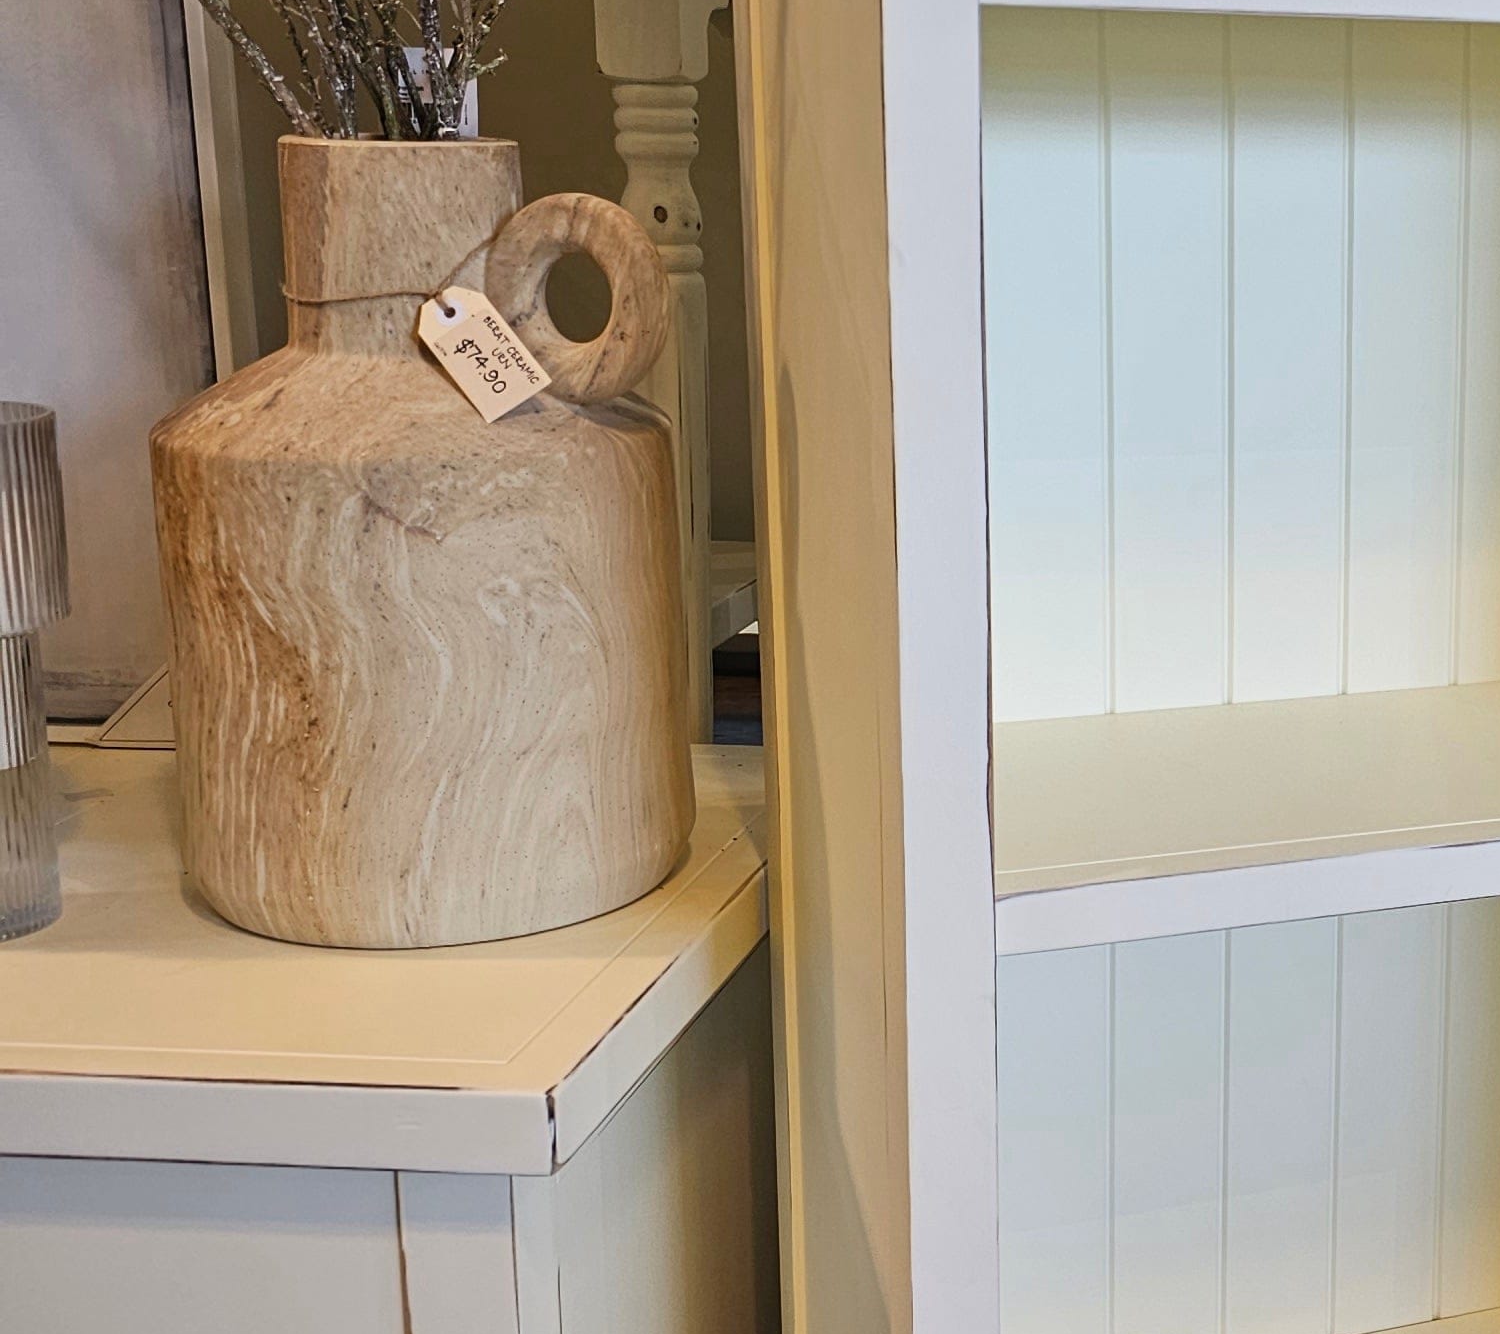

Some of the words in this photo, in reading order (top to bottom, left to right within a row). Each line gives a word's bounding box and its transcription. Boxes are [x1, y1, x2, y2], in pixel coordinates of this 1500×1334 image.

[453, 338, 507, 394] $74.90
[483, 316, 510, 344] BERAT
[507, 346, 539, 385] CERAMIC
[491, 347, 512, 370] URN
